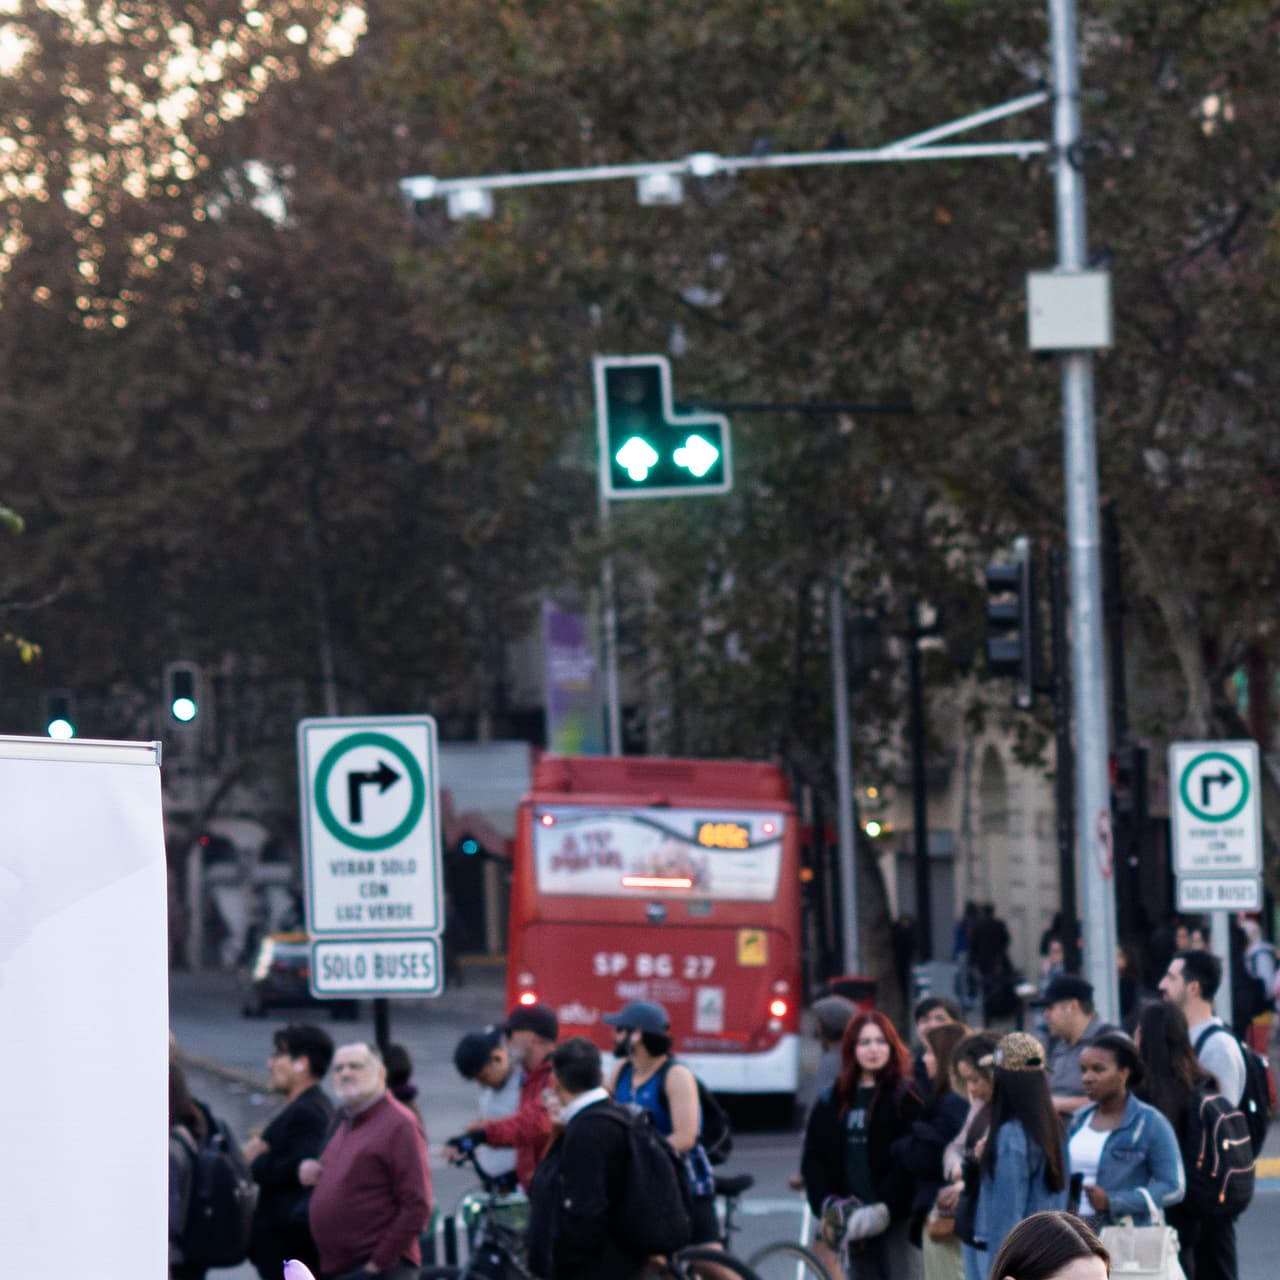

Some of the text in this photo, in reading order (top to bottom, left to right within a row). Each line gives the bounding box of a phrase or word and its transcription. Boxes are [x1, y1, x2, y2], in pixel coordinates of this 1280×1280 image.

[330, 858, 416, 876] VIRAR SOLO
[360, 881, 389, 898] CON
[336, 903, 413, 922] LUZ VERDE
[322, 953, 431, 981] SOLO BUSES
[593, 951, 628, 976] SP
[682, 954, 716, 979] 27
